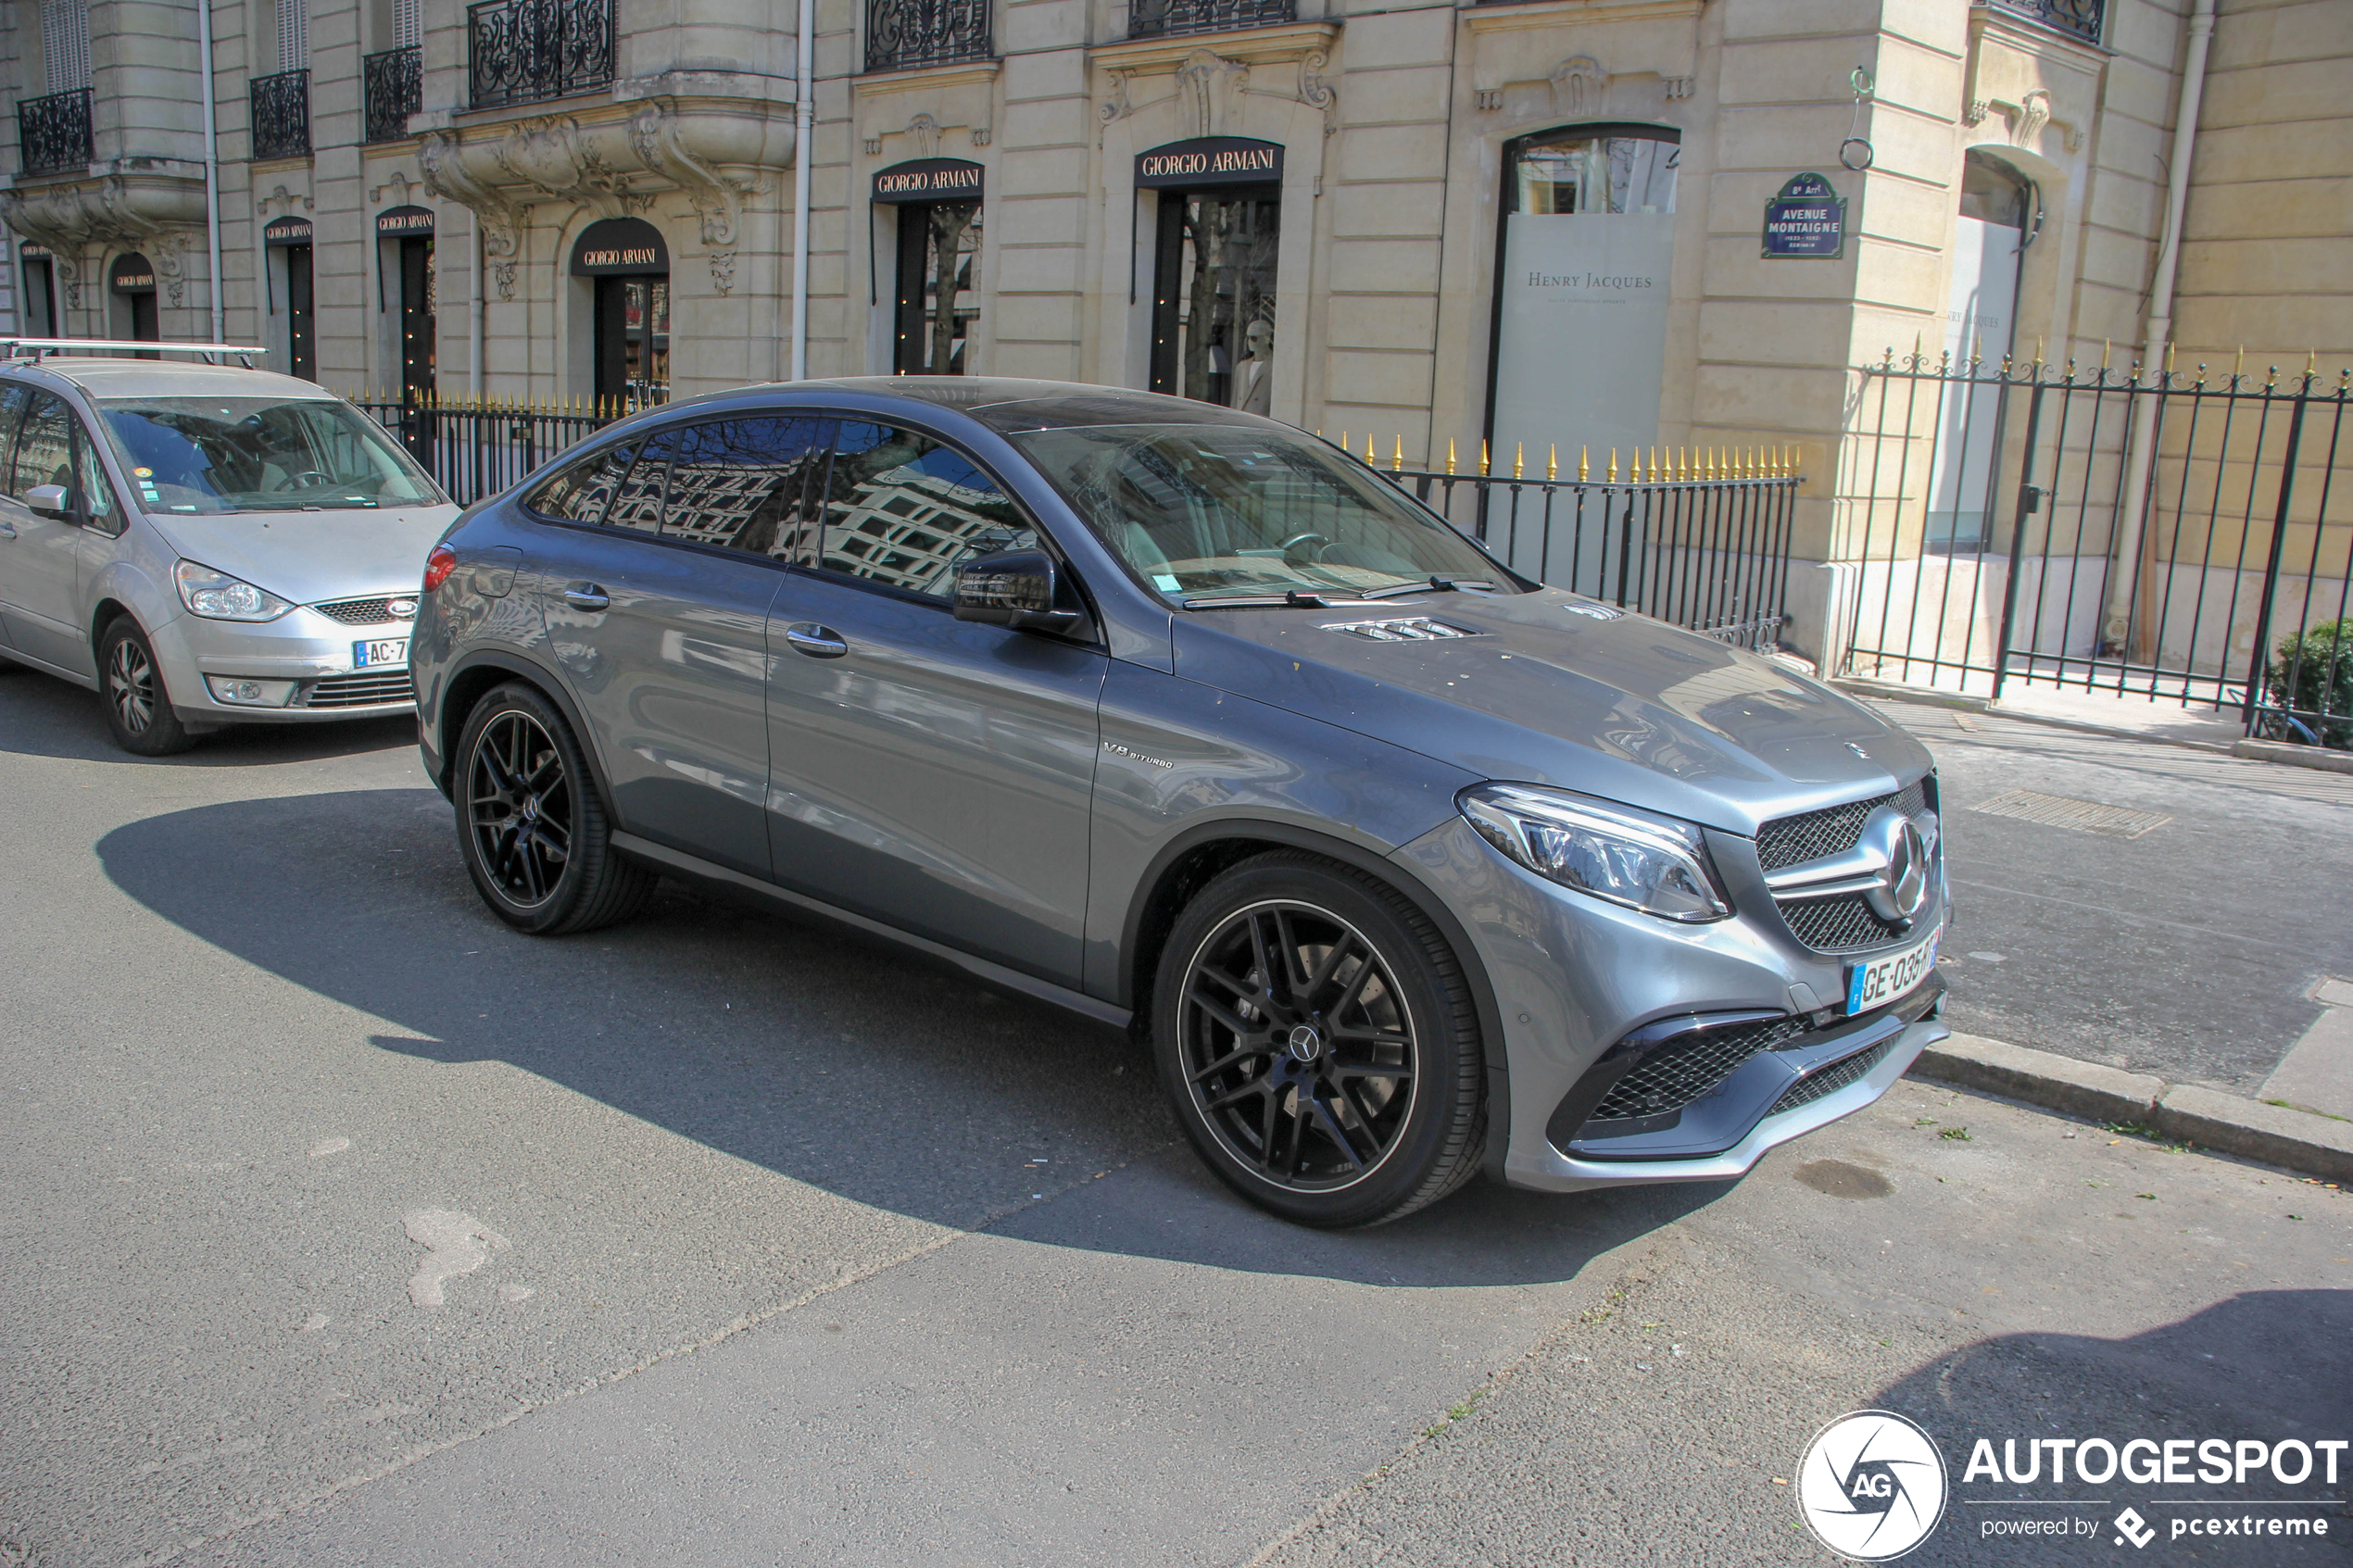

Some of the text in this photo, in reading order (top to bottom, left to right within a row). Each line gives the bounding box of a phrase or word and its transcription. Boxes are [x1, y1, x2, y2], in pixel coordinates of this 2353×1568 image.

[1142, 148, 1275, 176] GIORGIO ARMANI
[878, 168, 980, 193] GIORGIO ARMANI
[379, 213, 434, 230] GIORGIO ARMANI
[1781, 208, 1828, 220] AVENUE
[266, 223, 312, 239] GIORGIO ARMANI
[1768, 222, 1840, 233] MONTAIGNE
[585, 247, 656, 267] GIORGIO ARMANI
[1103, 742, 1174, 769] V8 BITURBO
